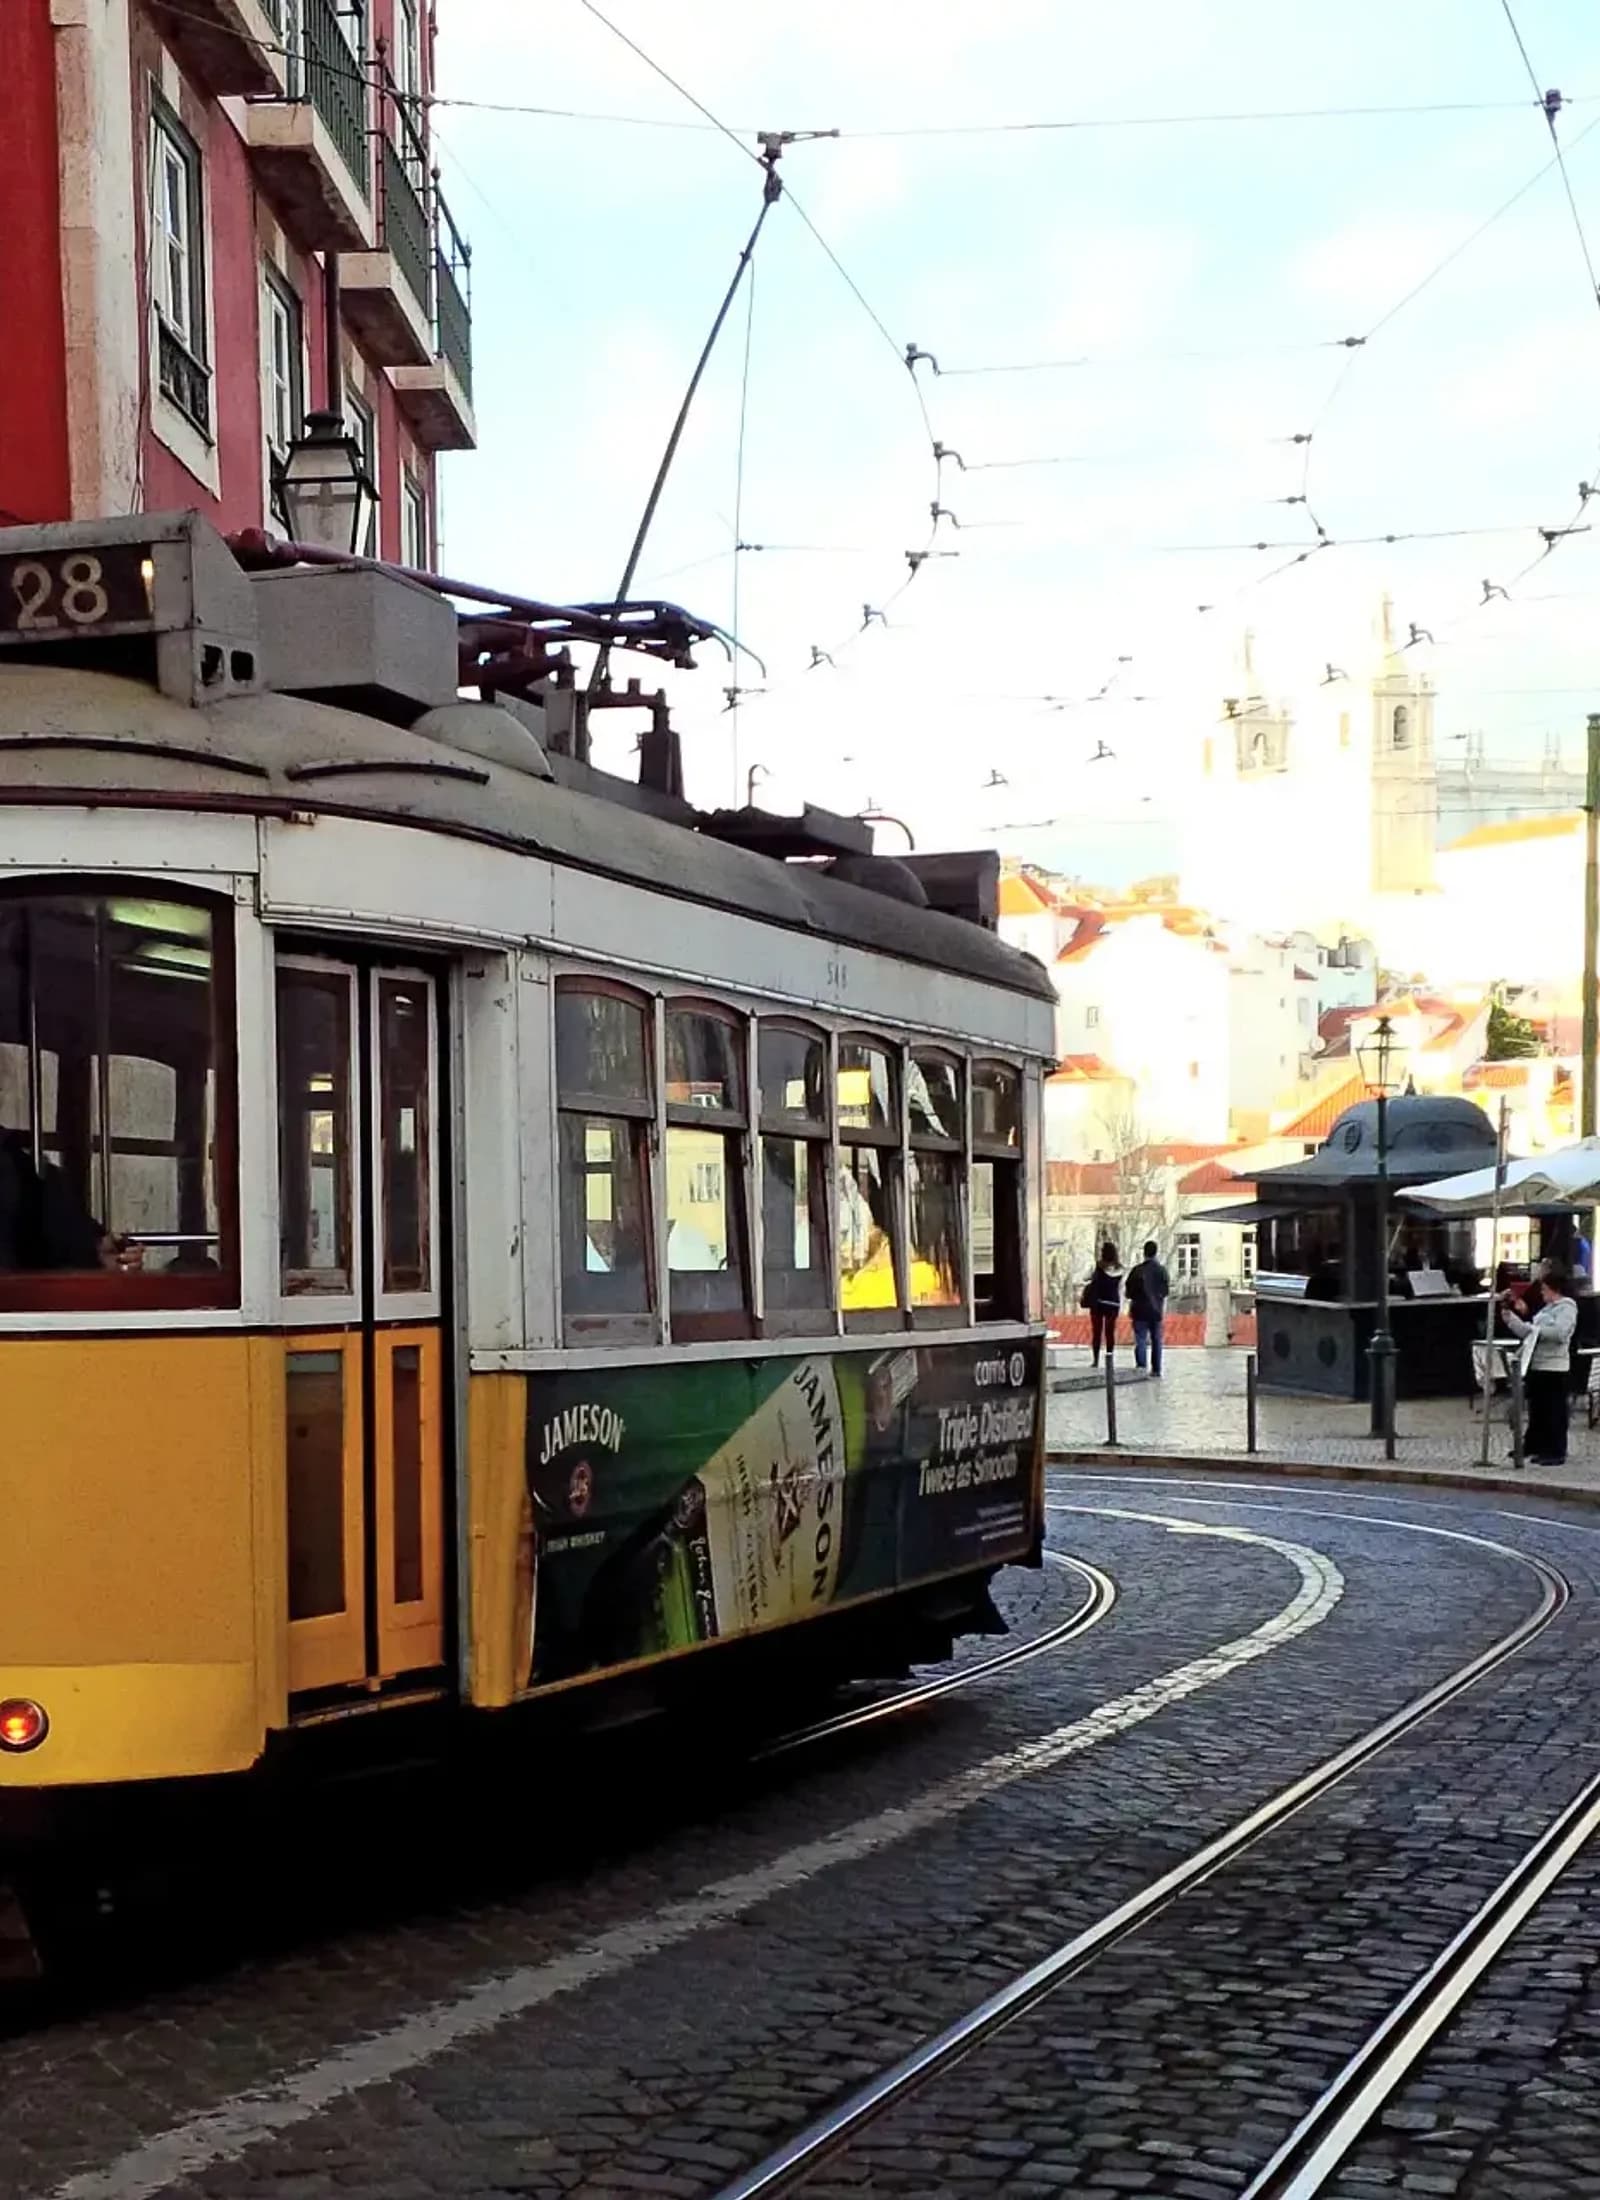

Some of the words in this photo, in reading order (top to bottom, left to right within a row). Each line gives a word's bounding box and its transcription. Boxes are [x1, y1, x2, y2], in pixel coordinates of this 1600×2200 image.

[11, 553, 109, 629] 28
[540, 1403, 624, 1465] JAMESON
[938, 1402, 977, 1460] Triple
[980, 1395, 1034, 1445] Distilled
[793, 1365, 834, 1602] JAMESON
[918, 1456, 955, 1496] Twice
[956, 1461, 972, 1488] as
